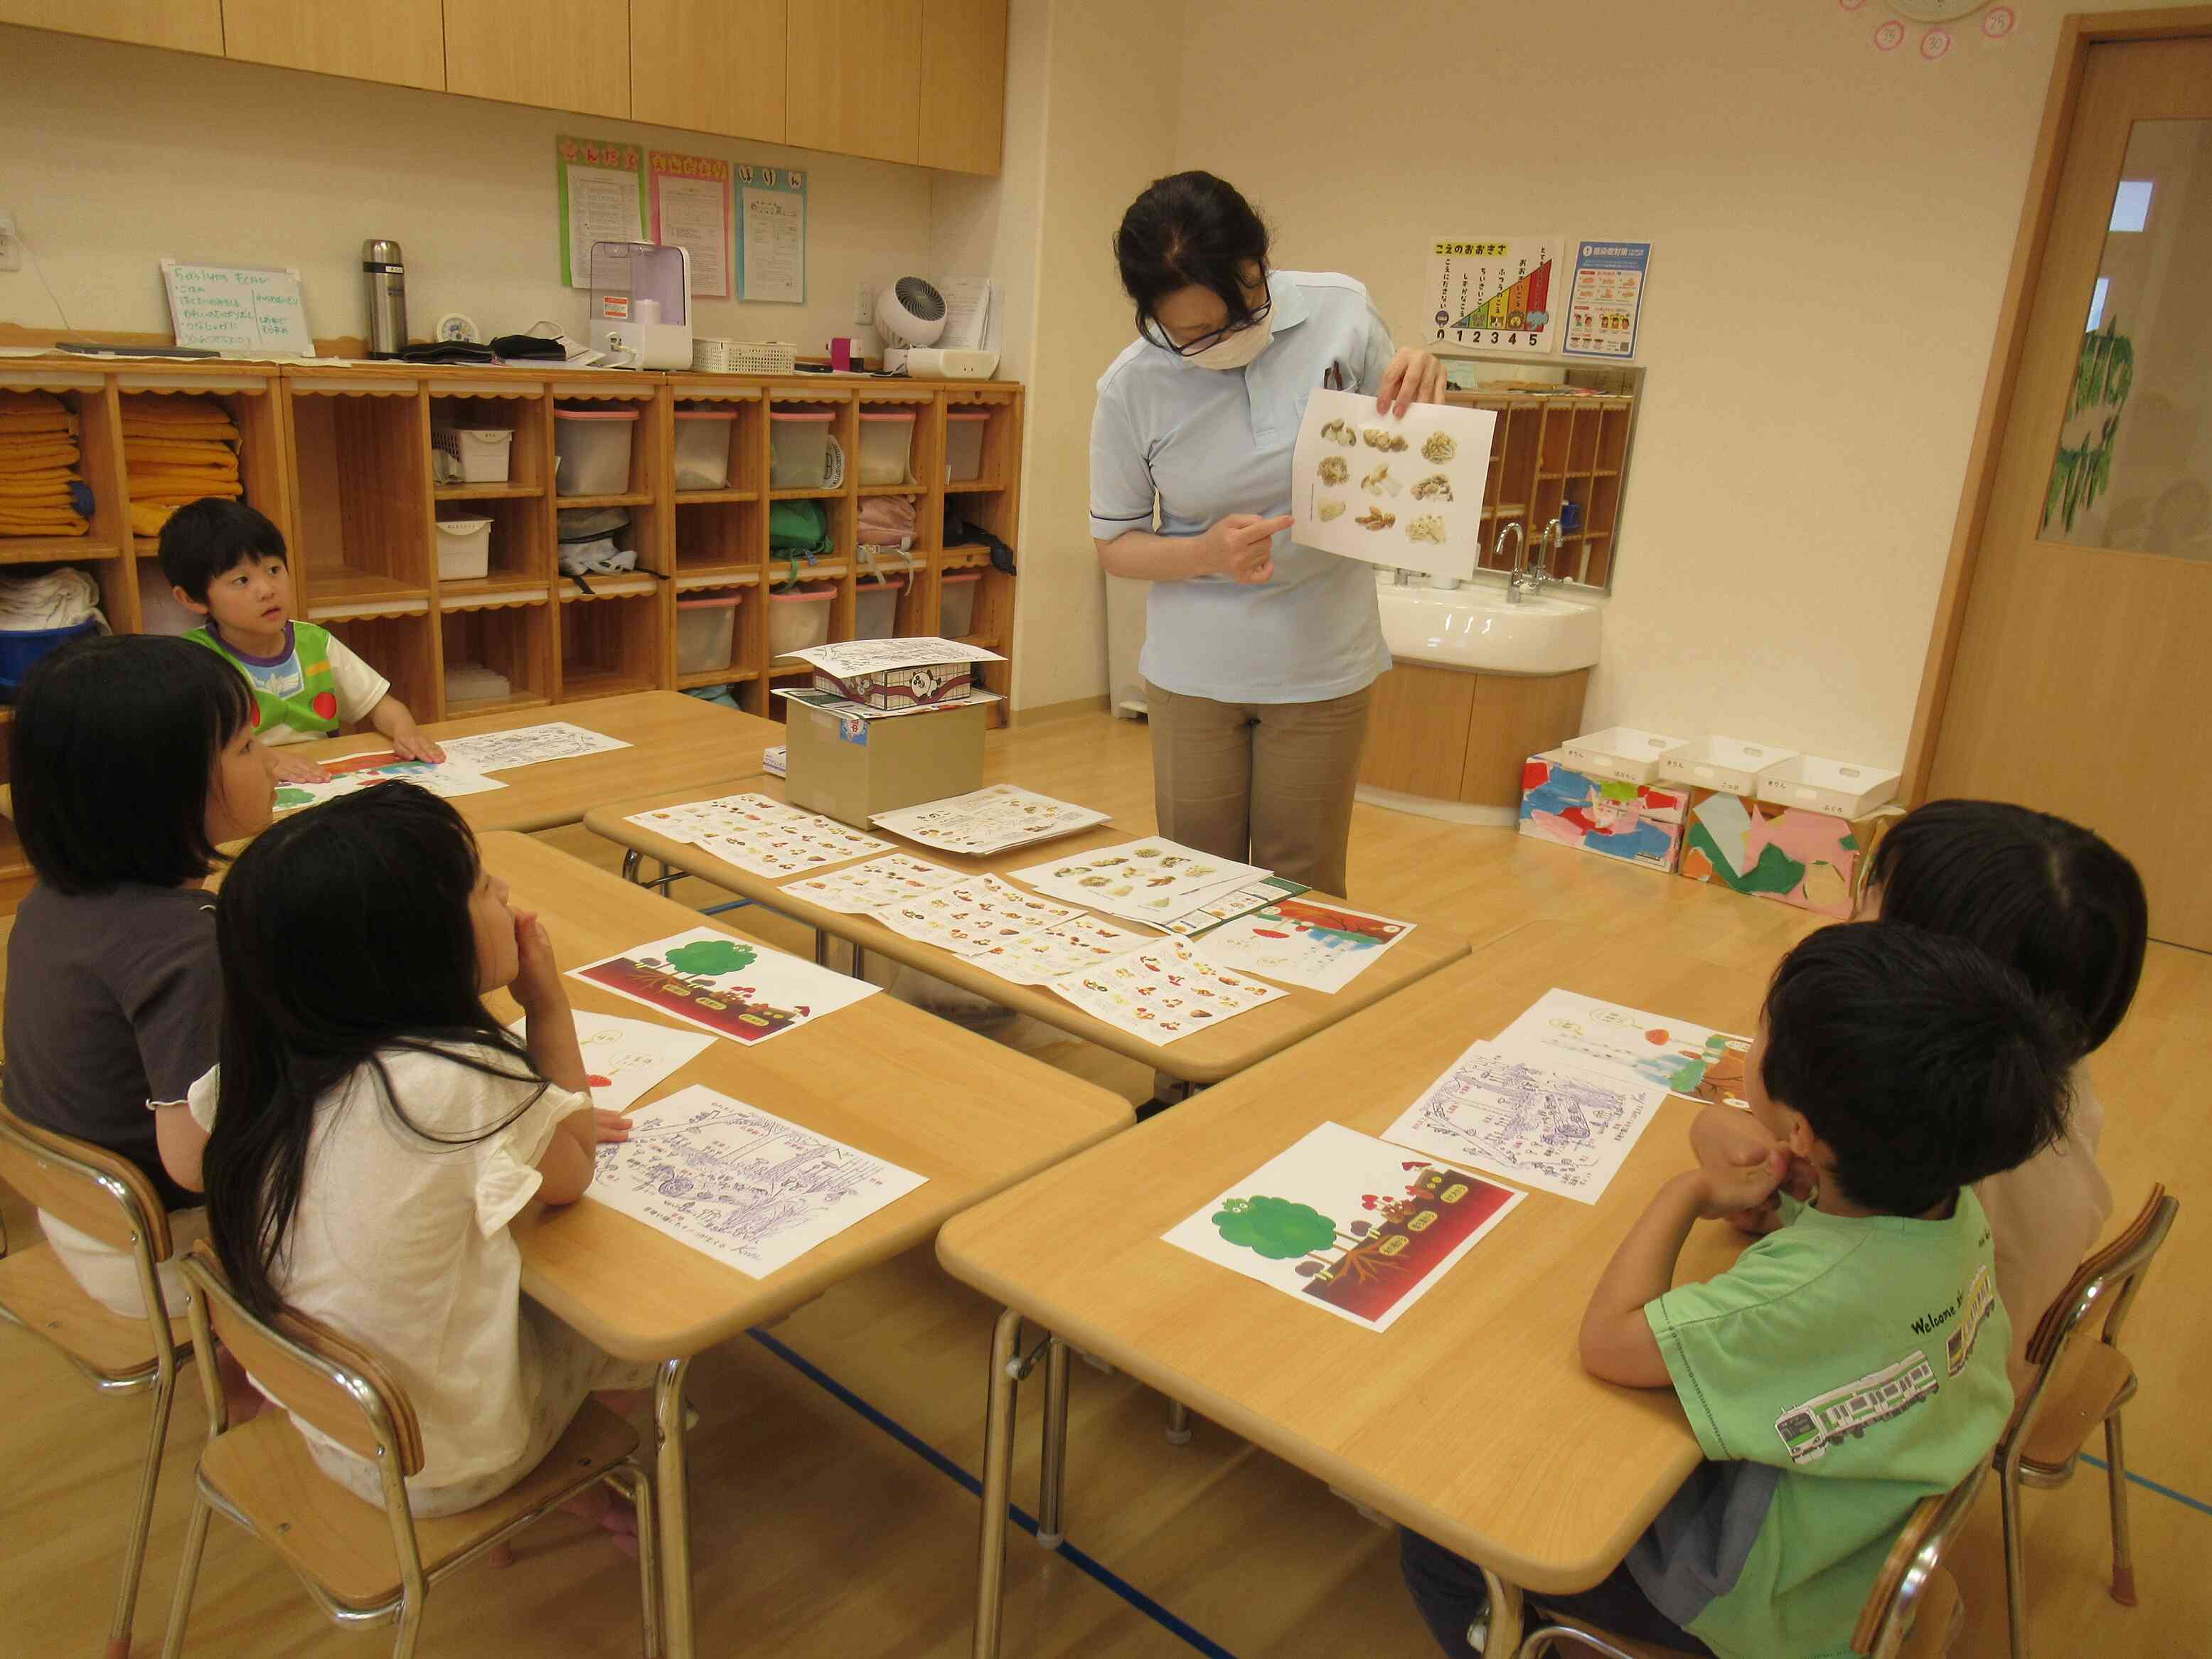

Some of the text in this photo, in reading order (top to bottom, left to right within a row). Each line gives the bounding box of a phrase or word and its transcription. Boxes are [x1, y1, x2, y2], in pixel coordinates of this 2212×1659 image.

[740, 166, 801, 186] ほけん
[1435, 244, 1507, 256] こえのおおきさ
[1440, 258, 1451, 309] こえにださない
[1459, 272, 1468, 318] しずかなこえ
[1495, 268, 1506, 314] ふつうのこえ
[1515, 259, 1527, 307] おおきいこえ
[1456, 330, 1463, 342] 1
[1473, 331, 1481, 343] 2
[1490, 331, 1500, 344] 3
[1508, 333, 1517, 345] 4
[1529, 334, 1538, 346] 5
[1911, 1306, 1957, 1336] Welcome
